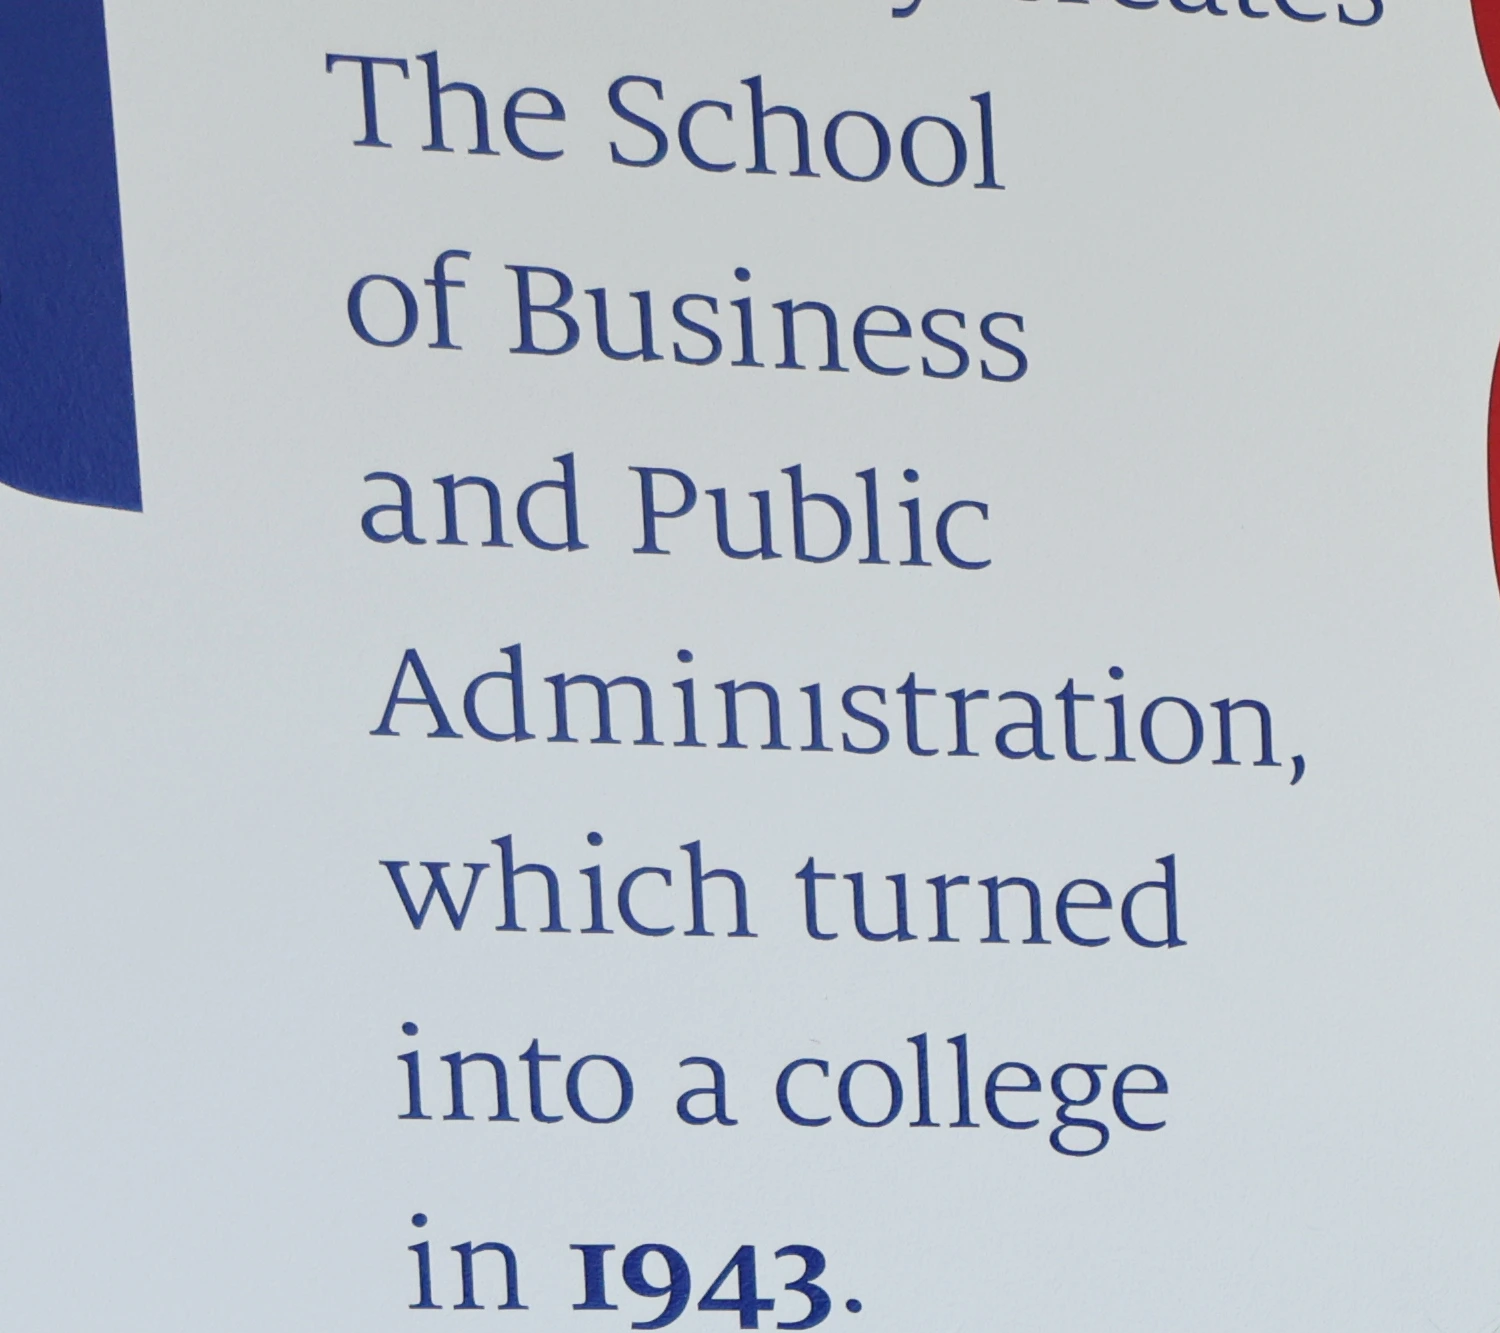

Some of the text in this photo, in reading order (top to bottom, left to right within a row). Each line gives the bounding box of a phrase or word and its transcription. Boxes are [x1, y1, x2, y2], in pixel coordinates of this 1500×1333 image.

[325, 49, 1006, 190] The School
[347, 249, 1028, 383] of Business
[361, 451, 992, 570] and Public
[369, 642, 1306, 786] Administration,
[378, 831, 1188, 949] which turned
[397, 1021, 1169, 1157] into a college
[407, 1212, 863, 1331] in 1943.
